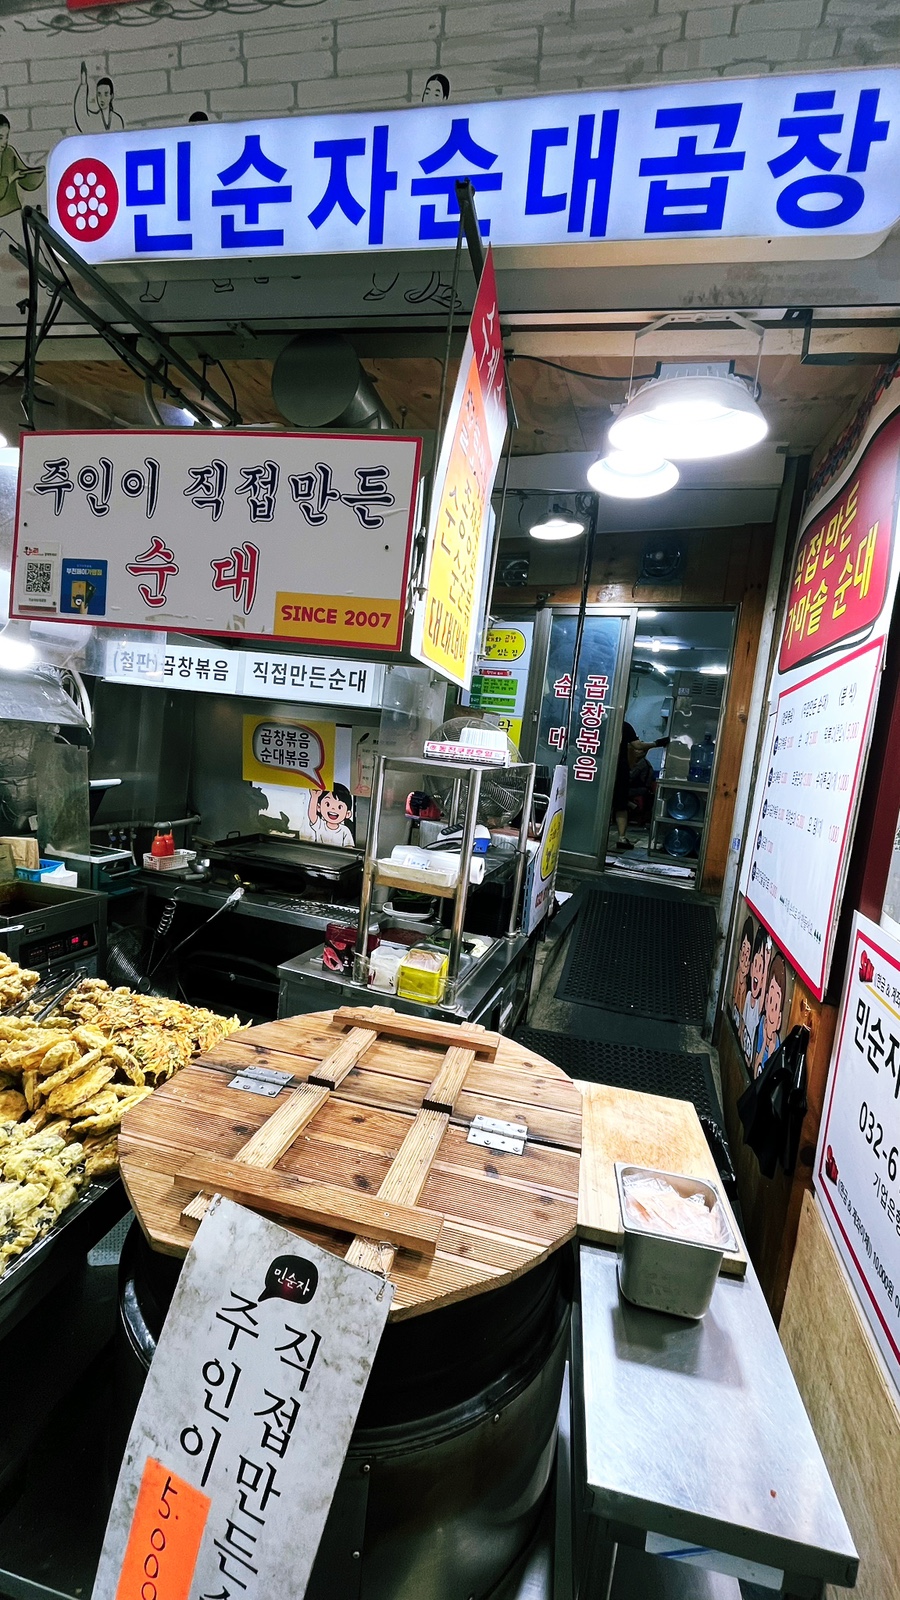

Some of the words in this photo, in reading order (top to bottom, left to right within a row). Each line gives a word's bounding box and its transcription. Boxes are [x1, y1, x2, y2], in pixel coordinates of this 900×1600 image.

[34, 457, 160, 519] 주인이
[183, 459, 396, 530] 직접만든
[832, 520, 880, 621] 순대
[282, 604, 337, 625] SINCE
[344, 609, 392, 630] 2007
[252, 660, 368, 694] 직접만든순대
[260, 728, 311, 750] 곱창볶음
[574, 674, 609, 783] 곱창볶음
[260, 747, 310, 768] 순대볶음
[274, 1266, 311, 1297] 민순자
[180, 1290, 260, 1488] 주인이
[199, 1323, 322, 1600] 직접만든
